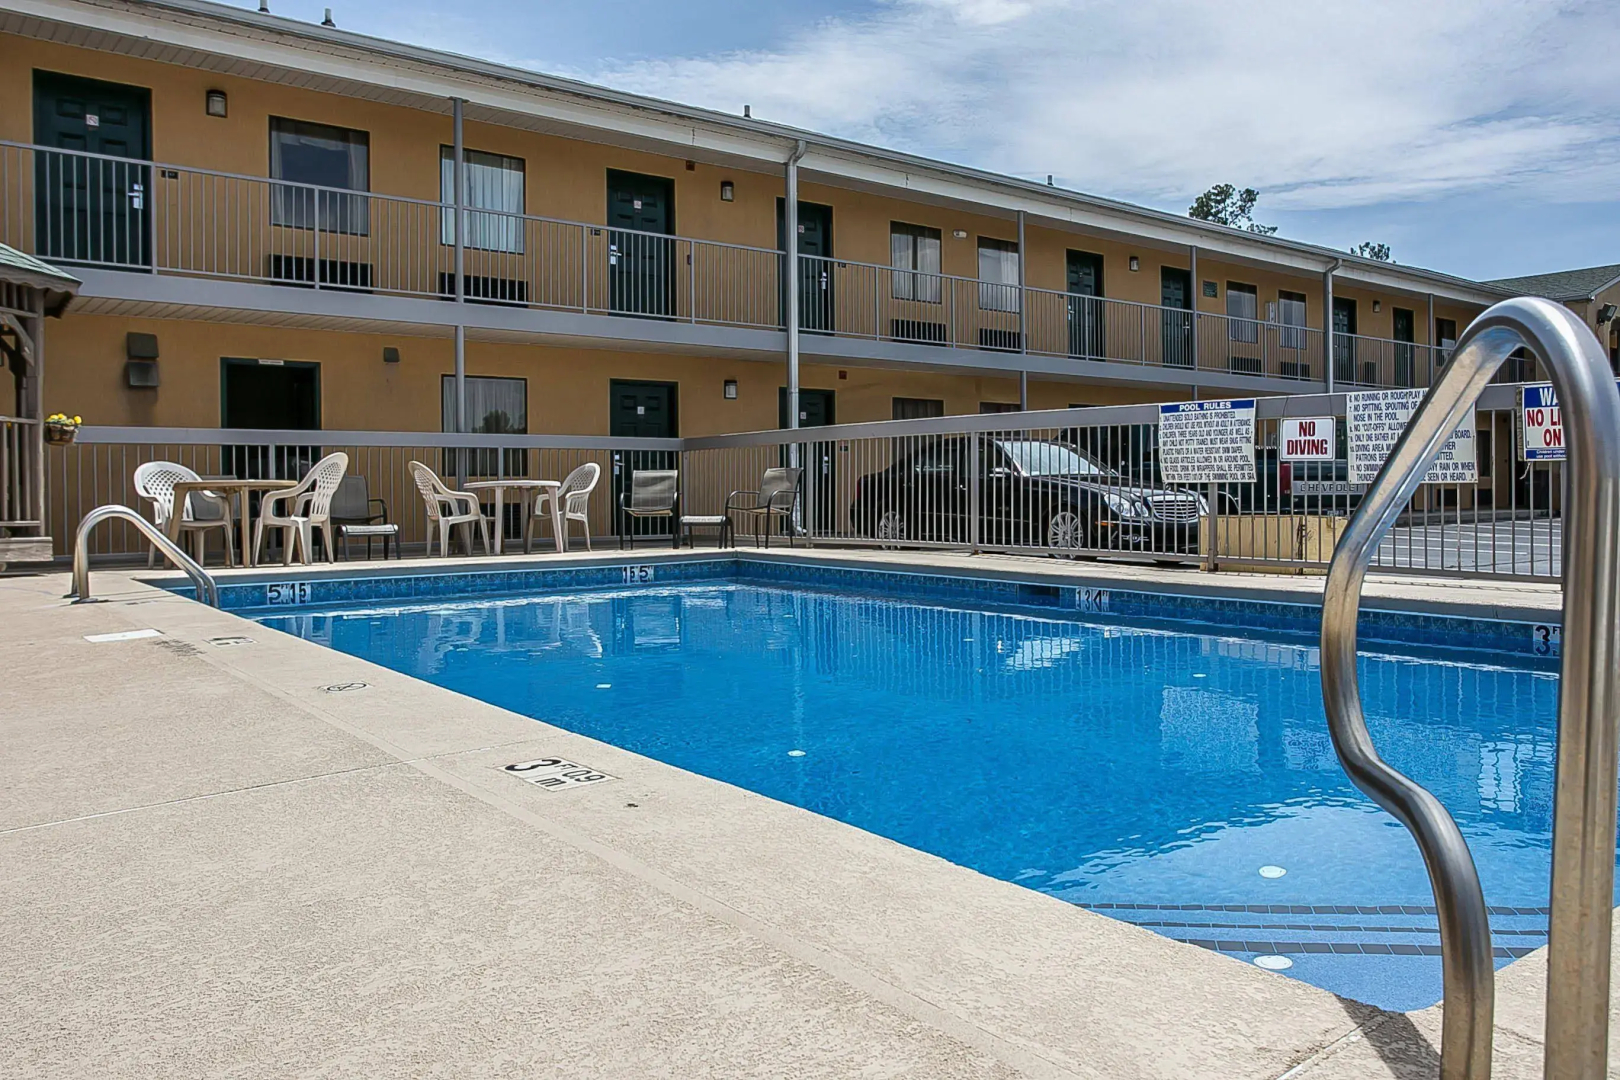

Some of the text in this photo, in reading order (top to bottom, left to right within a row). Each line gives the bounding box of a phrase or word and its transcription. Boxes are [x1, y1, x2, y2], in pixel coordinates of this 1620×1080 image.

[1362, 393, 1380, 401] RUNNING
[1390, 392, 1407, 400] ROUGH
[1409, 391, 1420, 399] PLAY
[1385, 402, 1409, 410] SPOUTING
[1163, 414, 1183, 422] UNATTENDED
[1526, 409, 1544, 427] NO
[1299, 421, 1316, 437] NO
[1375, 433, 1389, 441] BATHER
[1544, 428, 1561, 446] ON
[1287, 439, 1328, 455] DIVING
[1439, 462, 1450, 471] RAIN
[1452, 462, 1459, 471] OR
[1461, 462, 1474, 470] WHEN
[505, 759, 562, 772] 3
